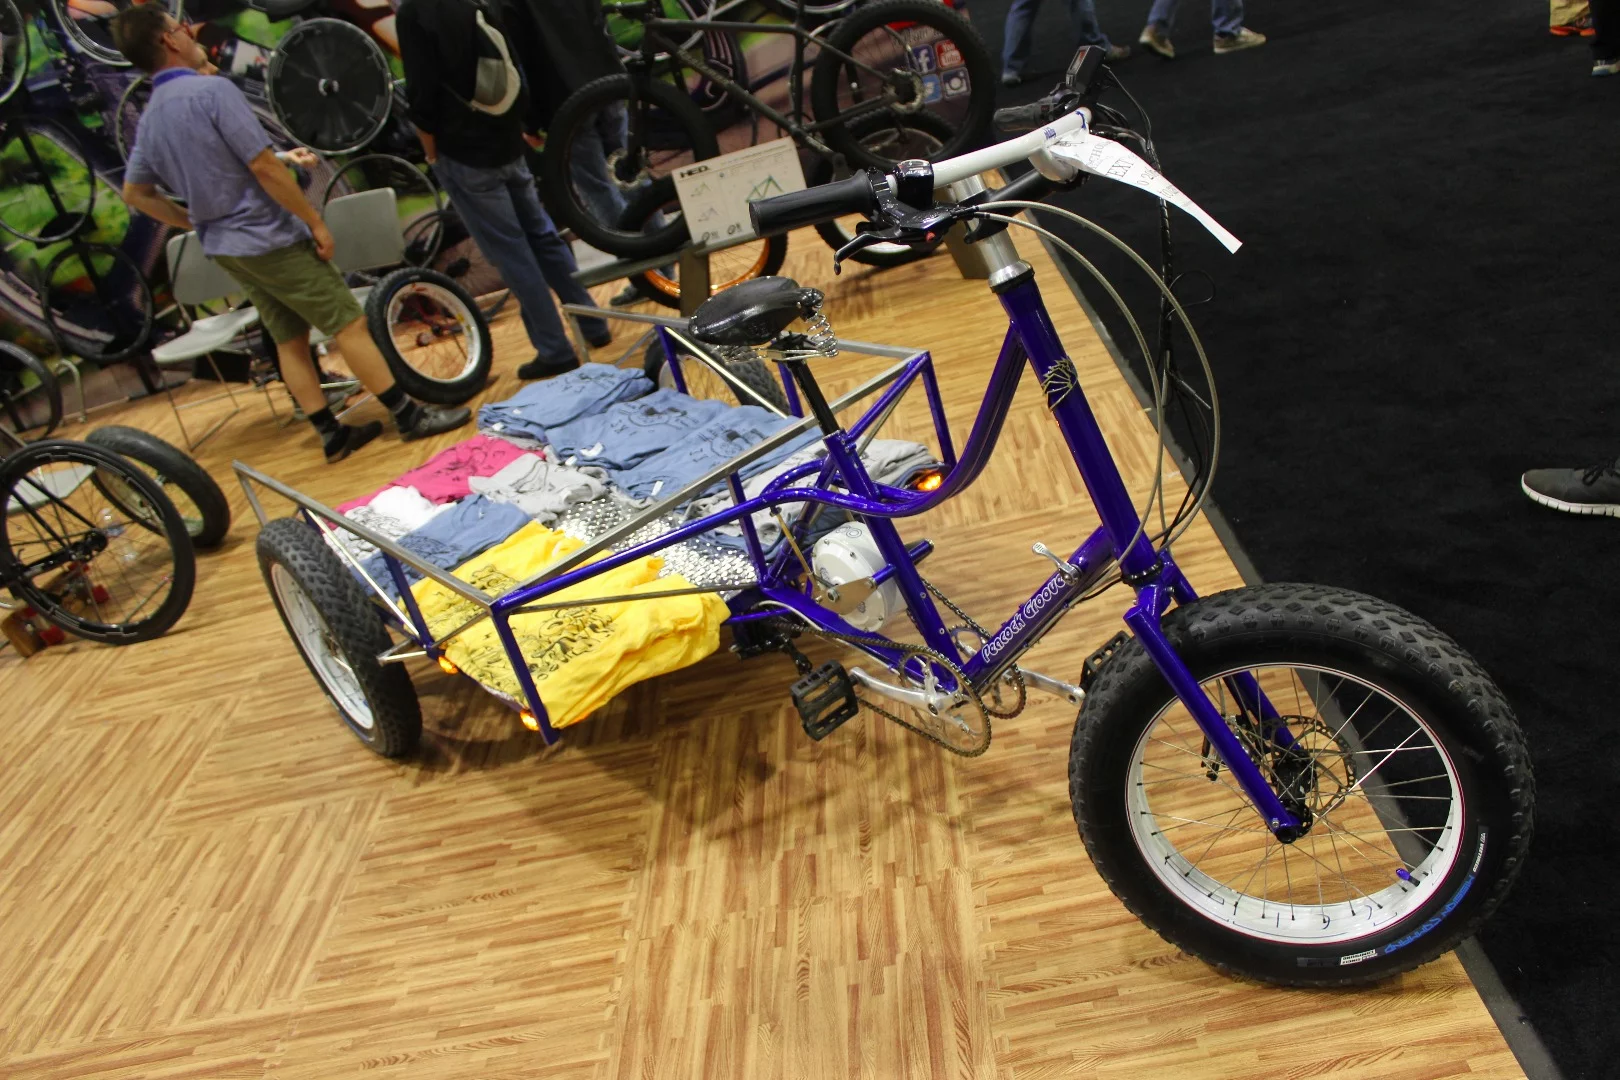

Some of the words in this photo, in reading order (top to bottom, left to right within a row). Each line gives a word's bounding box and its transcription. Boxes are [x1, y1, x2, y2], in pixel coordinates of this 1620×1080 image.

[981, 613, 1026, 663] Peacock
[1023, 574, 1067, 619] Groove
[1441, 874, 1475, 919] MISSION
[1384, 916, 1441, 954] COMMAND
